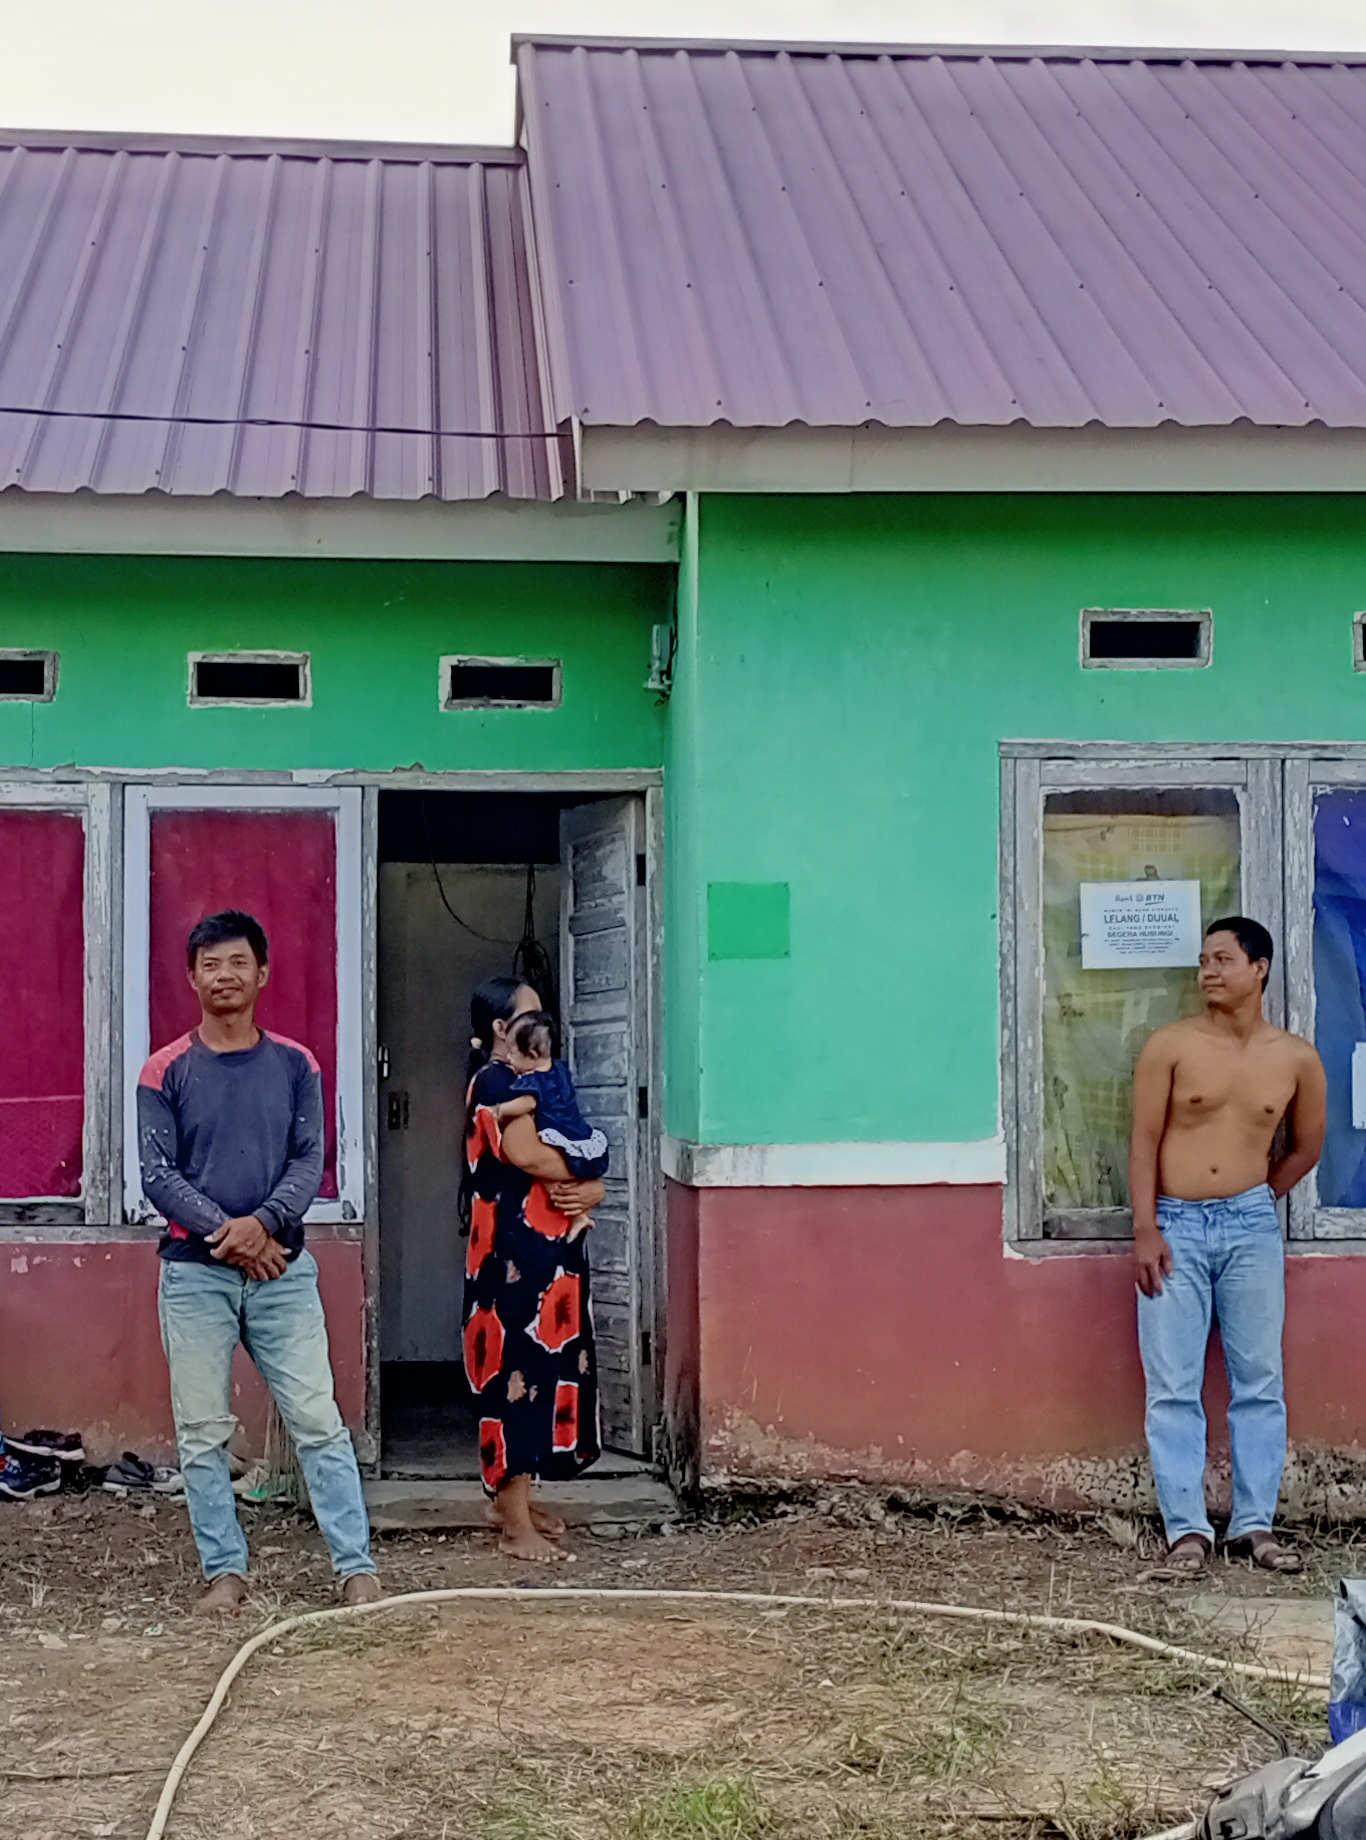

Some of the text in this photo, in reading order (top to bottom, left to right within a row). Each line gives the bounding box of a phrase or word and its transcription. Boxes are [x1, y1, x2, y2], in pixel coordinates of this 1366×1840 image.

[1145, 893, 1165, 902] BTN
[1103, 914, 1140, 924] LELANG
[1147, 913, 1180, 923] DIJUAL
